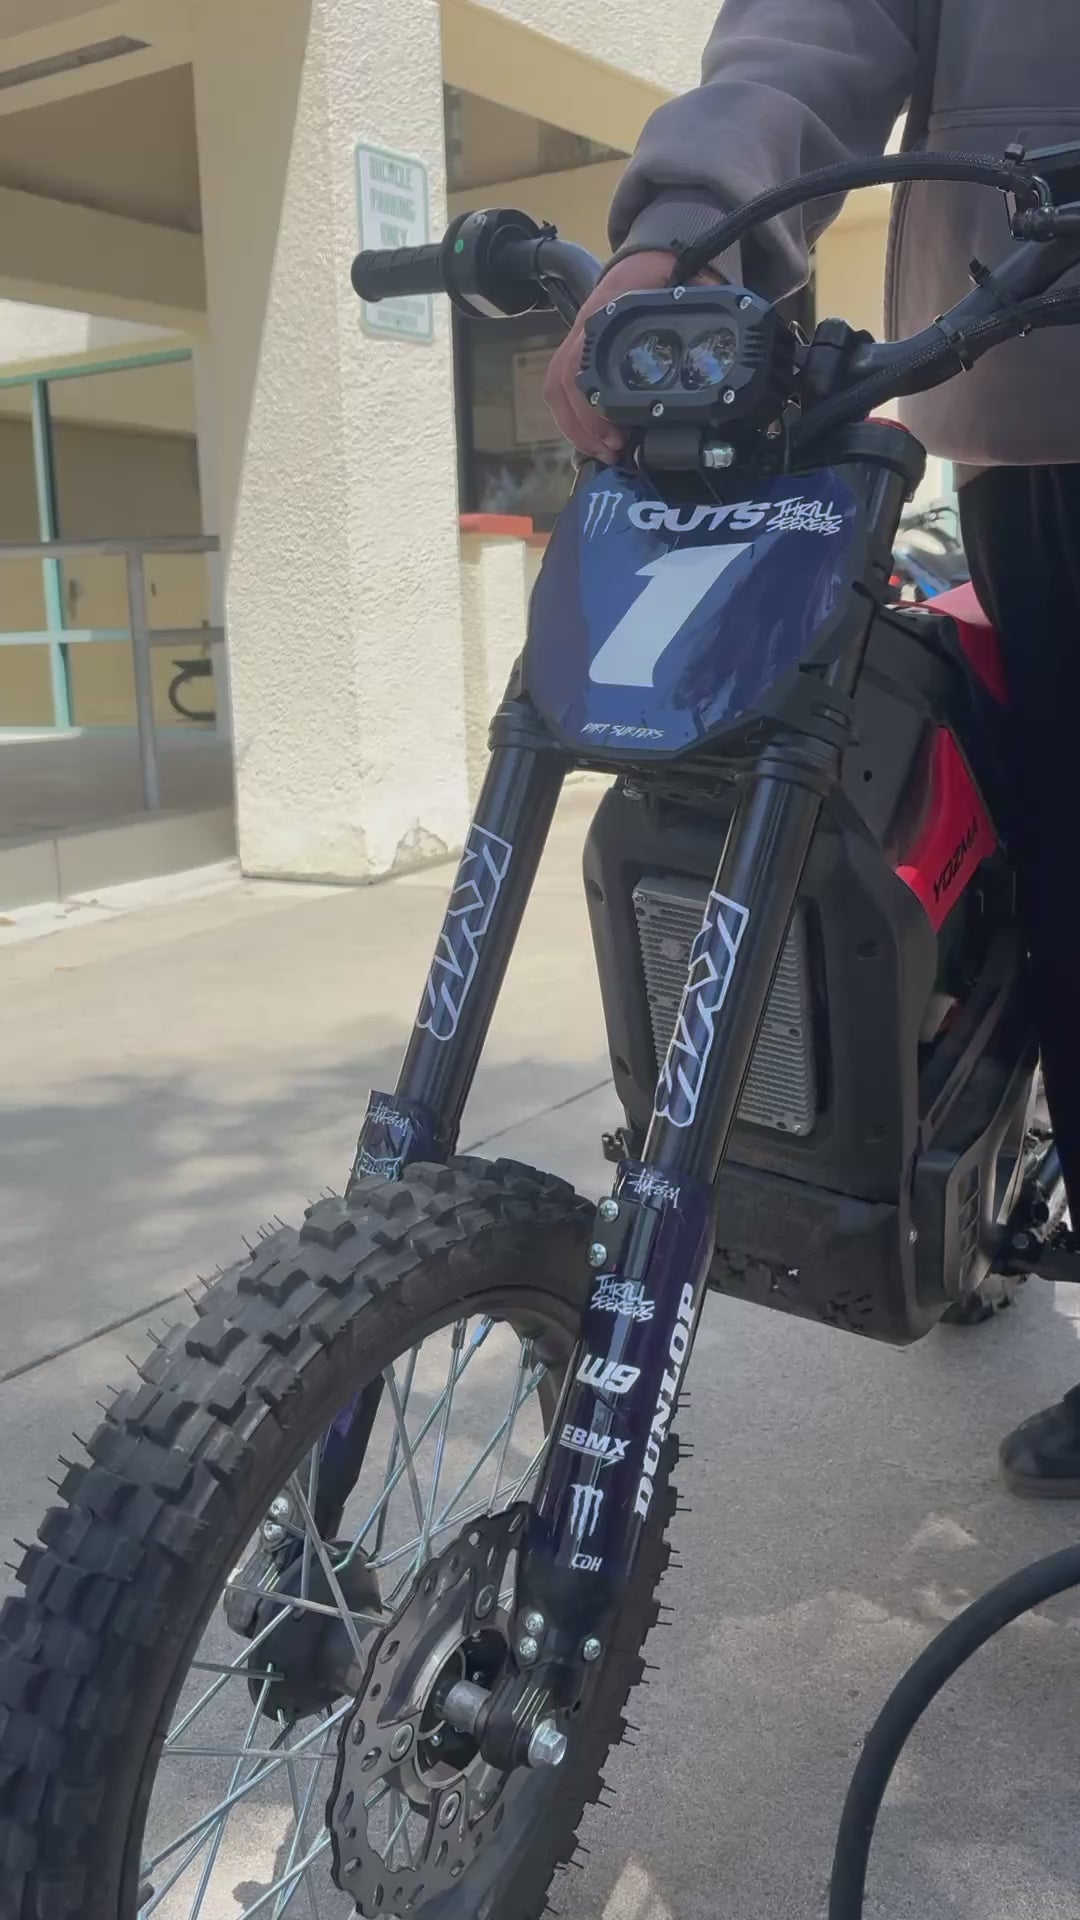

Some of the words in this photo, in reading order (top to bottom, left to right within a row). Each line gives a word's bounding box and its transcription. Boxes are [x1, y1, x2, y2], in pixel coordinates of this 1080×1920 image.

[370, 188, 416, 223] PARKING
[627, 500, 774, 532] GUTS
[765, 515, 843, 537] SEEKERS
[589, 542, 755, 688] 1
[634, 1282, 696, 1522] DUNLOP
[560, 1423, 631, 1457] EBMX
